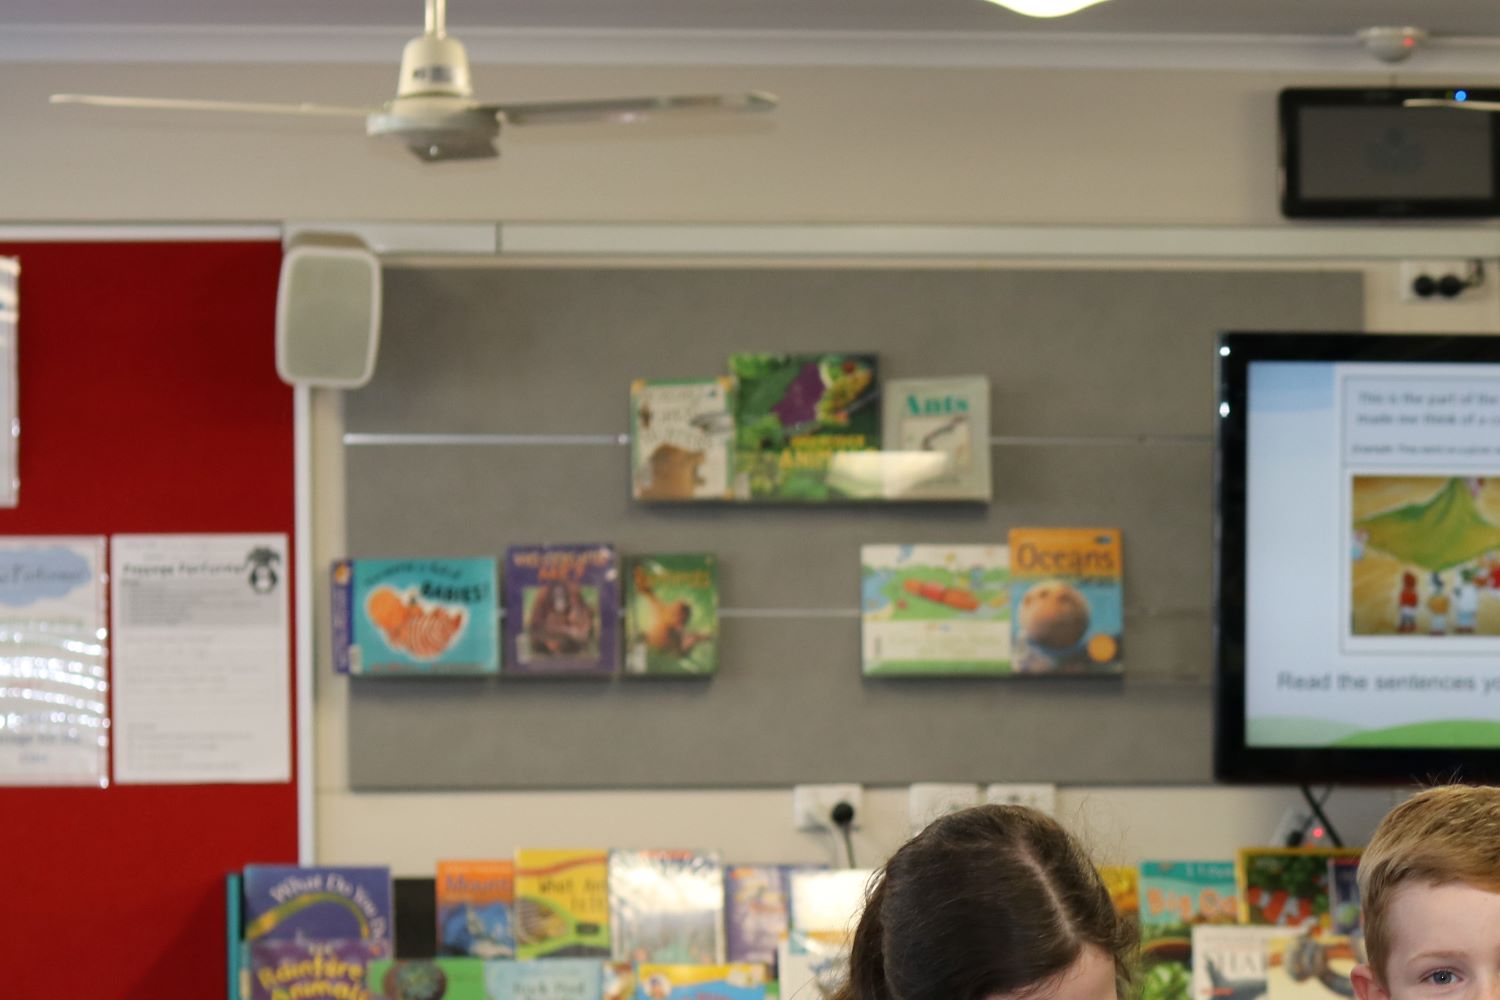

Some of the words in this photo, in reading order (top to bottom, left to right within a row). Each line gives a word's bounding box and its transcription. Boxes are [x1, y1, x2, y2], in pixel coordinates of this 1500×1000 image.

[906, 393, 970, 415] Ants
[1016, 542, 1116, 571] Oceans
[1277, 671, 1332, 692] Read
[1337, 672, 1368, 691] the
[1375, 673, 1476, 692] sentences
[269, 874, 322, 904] What
[326, 872, 355, 895] Do
